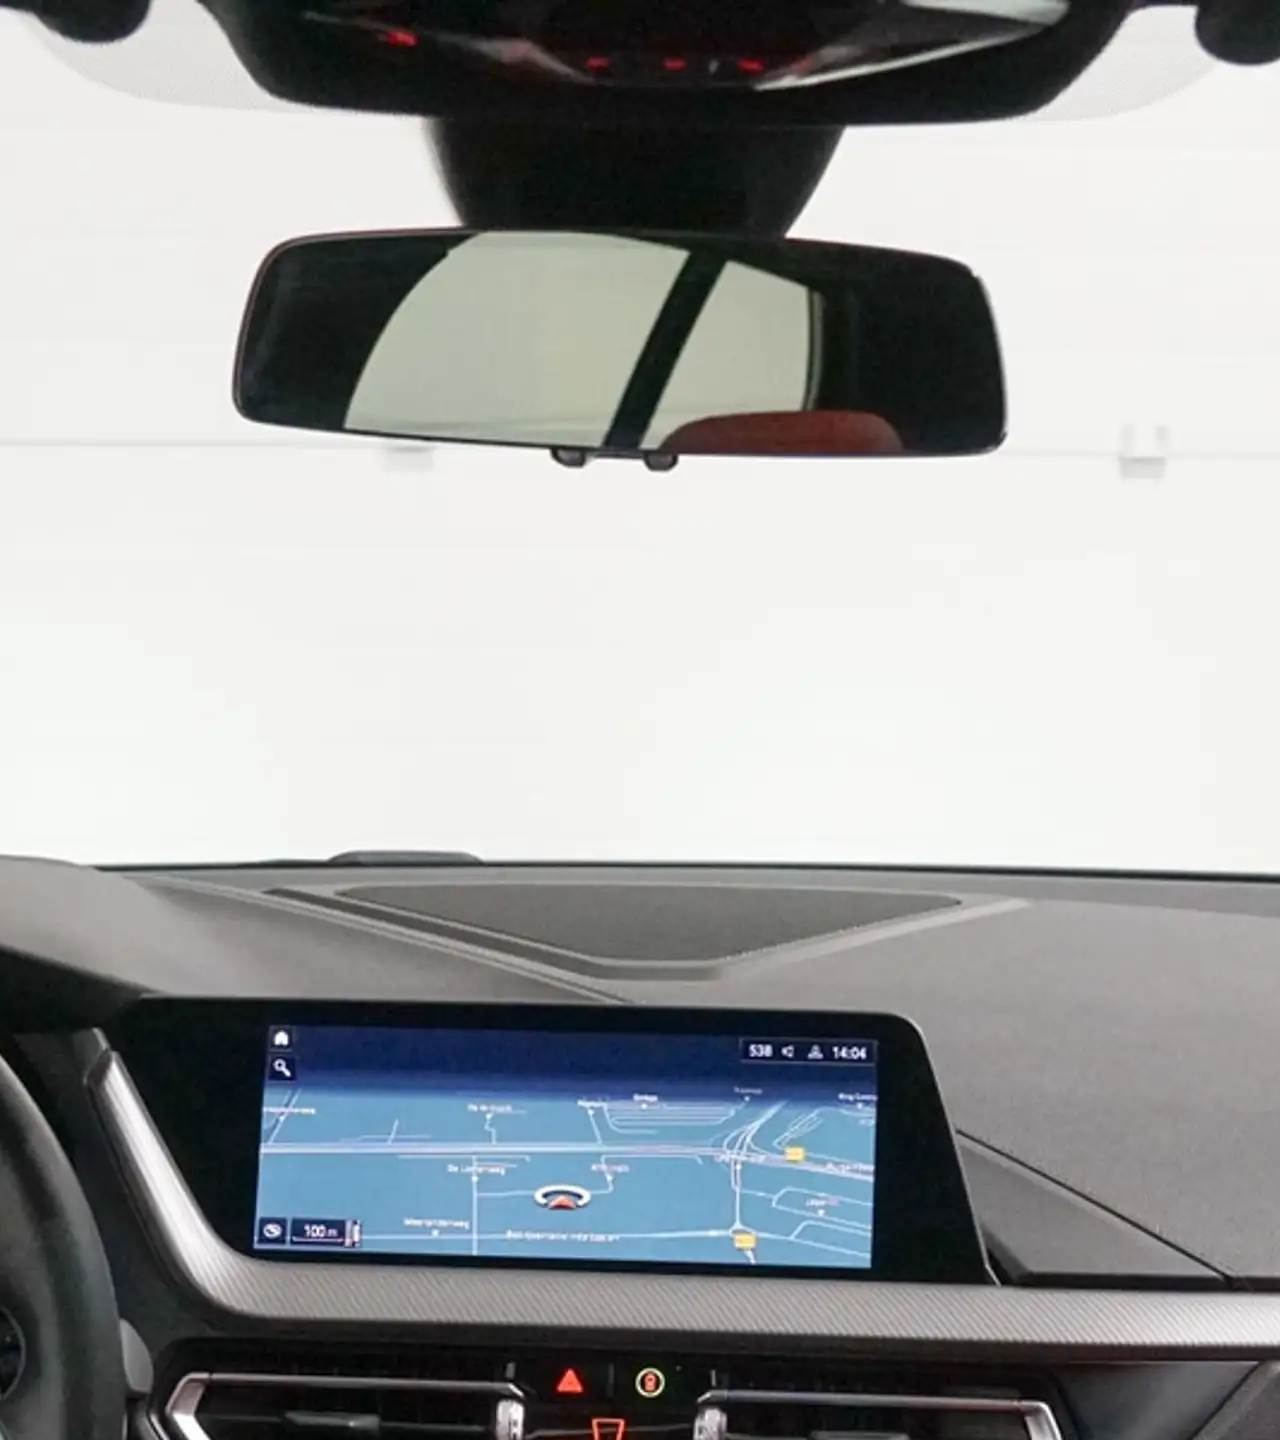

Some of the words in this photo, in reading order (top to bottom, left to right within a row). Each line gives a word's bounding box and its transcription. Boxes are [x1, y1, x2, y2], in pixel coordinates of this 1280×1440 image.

[749, 1045, 773, 1059] 538
[832, 1046, 867, 1060] 14:04
[303, 1224, 326, 1238] 100
